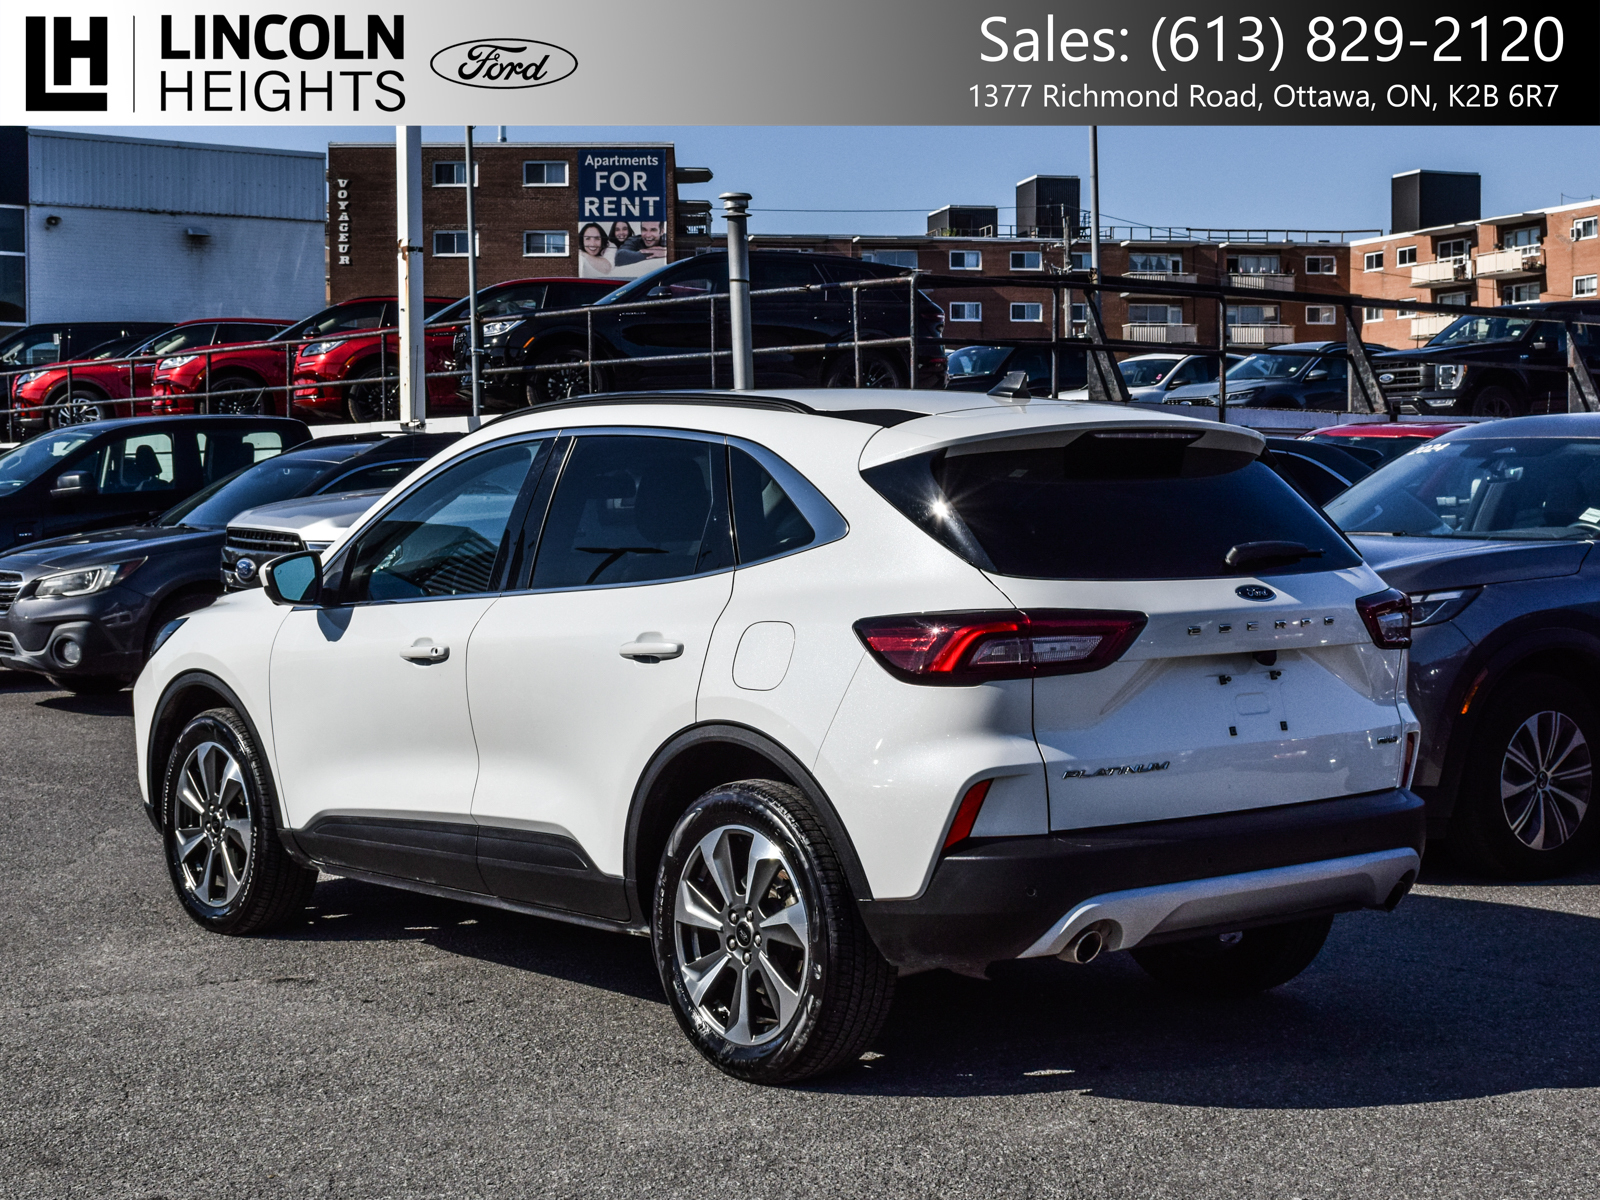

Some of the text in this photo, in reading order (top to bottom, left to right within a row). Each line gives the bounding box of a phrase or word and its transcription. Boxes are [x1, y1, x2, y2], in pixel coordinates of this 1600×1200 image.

[584, 154, 659, 169] Apartments
[595, 170, 648, 192] FOR
[584, 196, 660, 218] RENT
[337, 178, 350, 265] VOYAGEUR
[1062, 760, 1170, 780] PLATINUM
